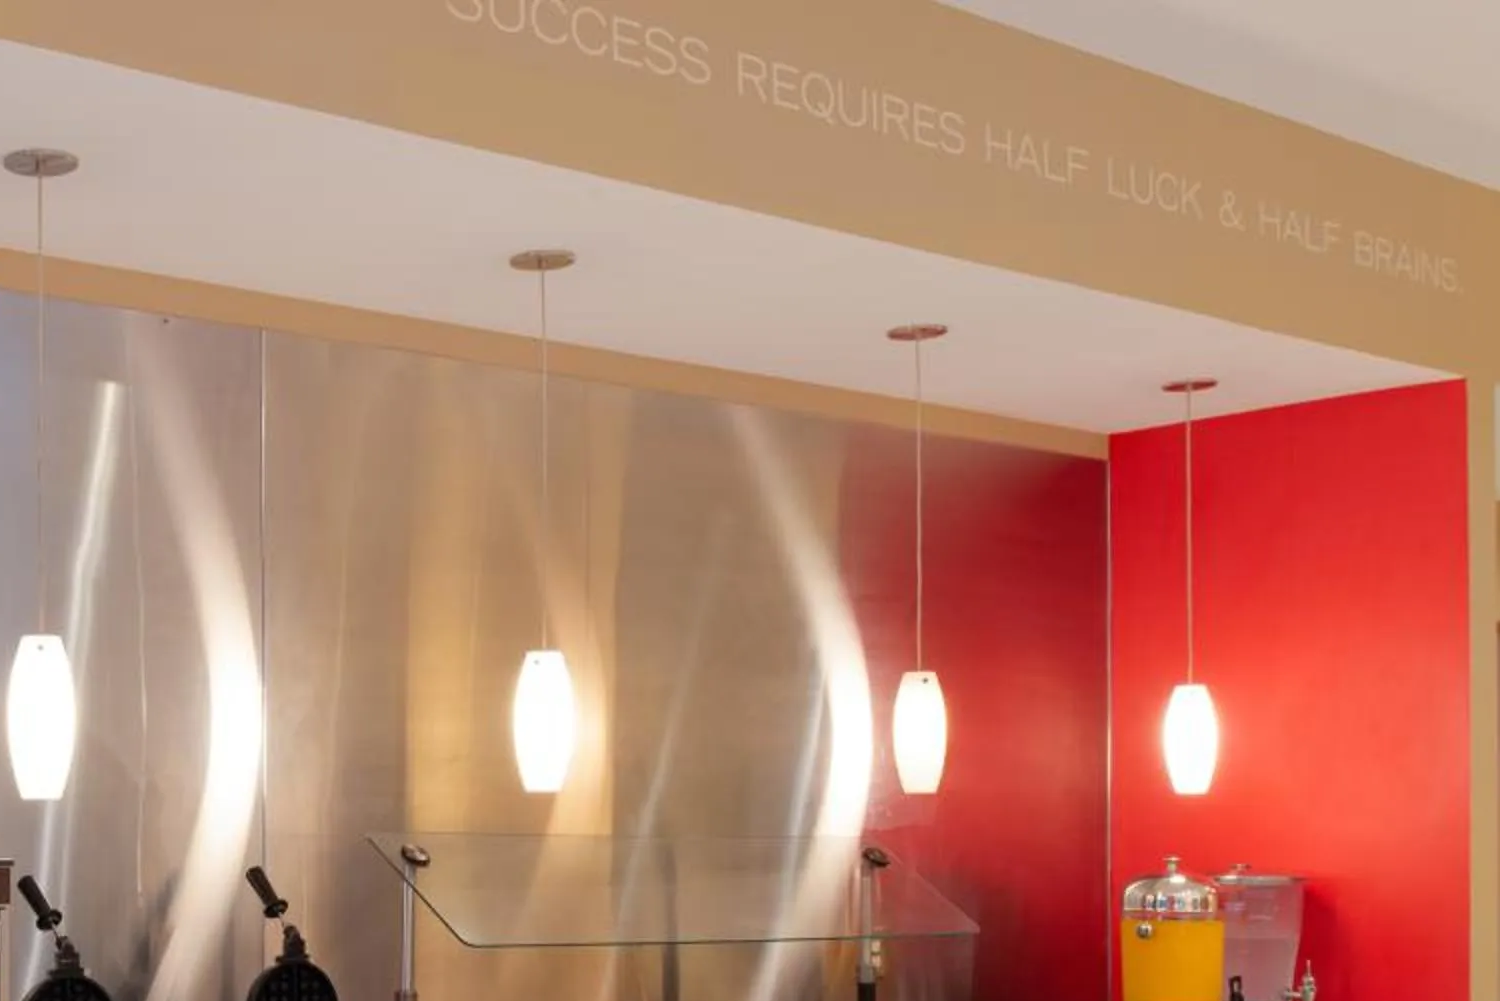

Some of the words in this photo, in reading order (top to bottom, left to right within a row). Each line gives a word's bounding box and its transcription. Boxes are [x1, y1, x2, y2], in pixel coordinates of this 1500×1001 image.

[736, 50, 966, 156] REQUIRES
[984, 121, 1091, 184] HALF
[1105, 155, 1204, 221] LUCK
[1218, 190, 1246, 232] &
[1256, 199, 1341, 254] HALF
